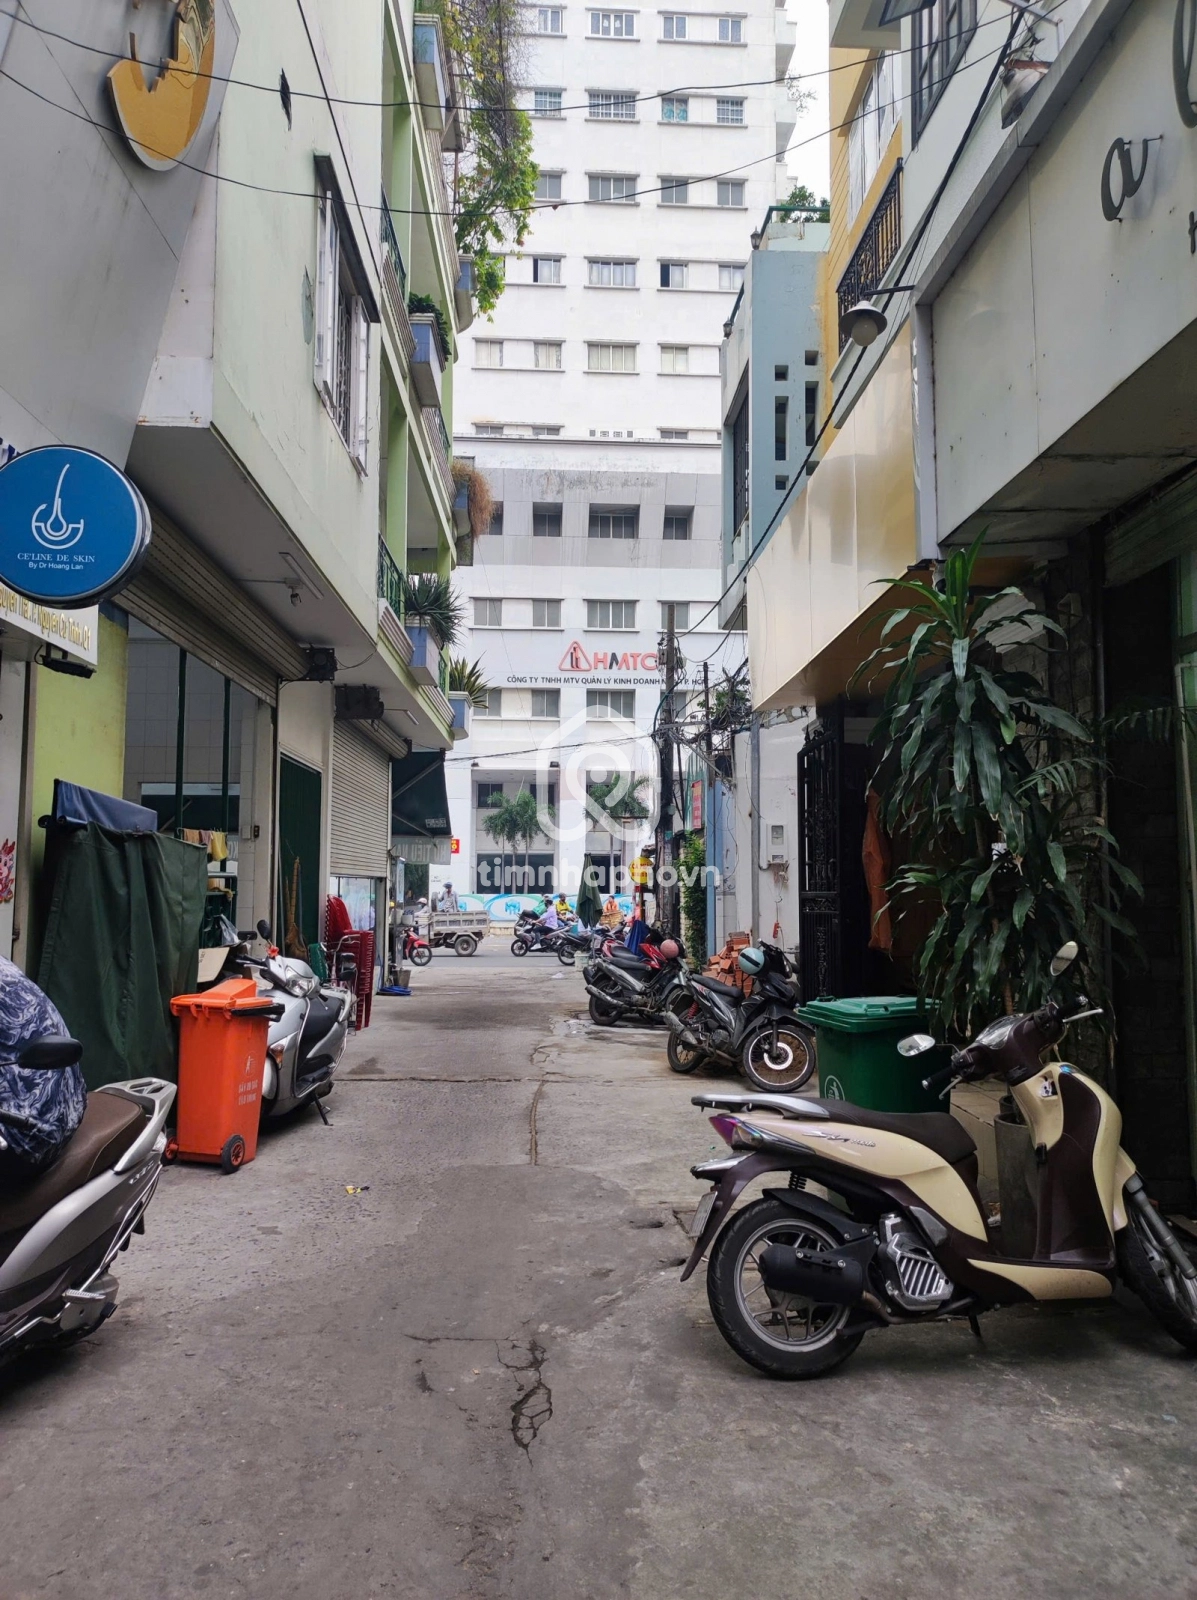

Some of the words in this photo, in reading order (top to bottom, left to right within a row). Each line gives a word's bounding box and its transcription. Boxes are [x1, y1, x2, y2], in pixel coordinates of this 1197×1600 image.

[56, 554, 70, 562] DE
[73, 555, 96, 563] SKIN
[28, 561, 37, 570] By
[48, 562, 70, 571] Hoang
[593, 652, 658, 671] HMTC
[507, 675, 528, 683] CÔNG
[581, 675, 602, 685] QUẢN
[603, 676, 612, 685] LÝ
[613, 677, 632, 685] KINH
